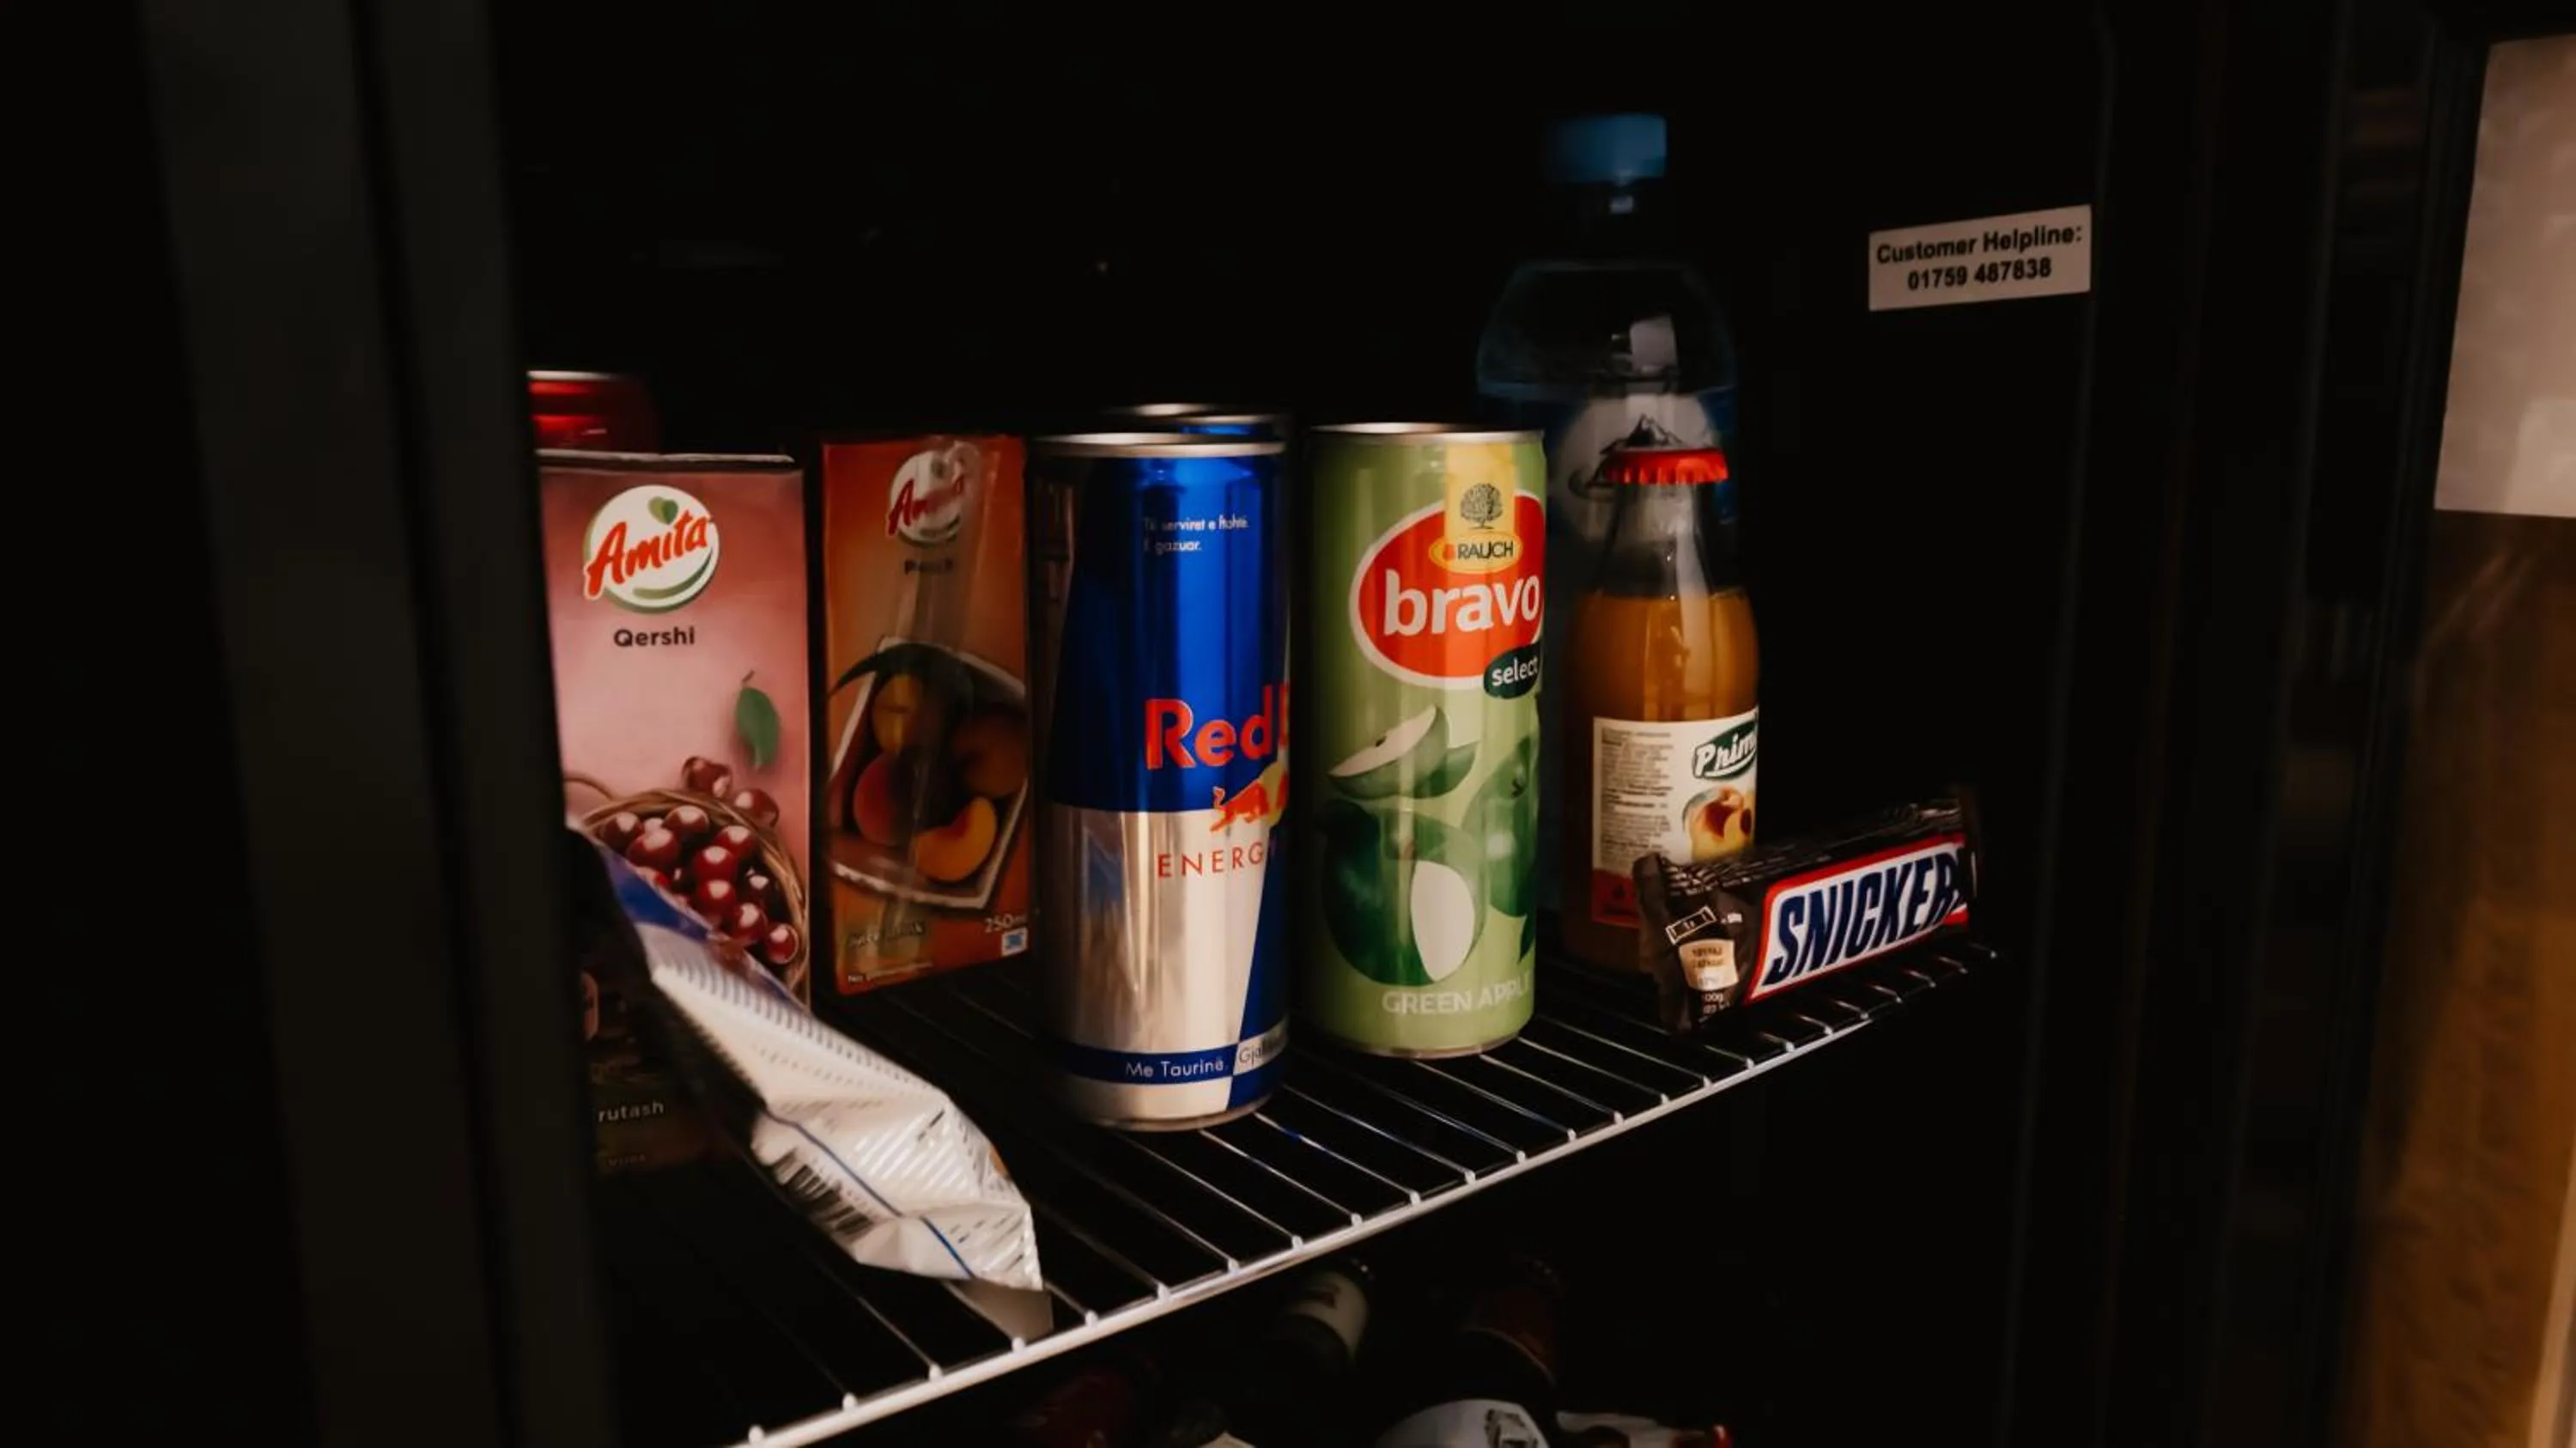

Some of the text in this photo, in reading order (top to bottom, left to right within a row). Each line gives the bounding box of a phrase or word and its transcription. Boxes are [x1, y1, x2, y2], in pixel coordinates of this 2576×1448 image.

[1877, 225, 2082, 263] Customer Helpline:
[1908, 257, 2051, 290] 01759 487838
[586, 510, 708, 596] Amita
[1457, 541, 1514, 560] RAUCH
[1383, 568, 1540, 637] bravo
[613, 626, 695, 647] Qershi
[1491, 656, 1539, 687] select
[1144, 684, 1273, 770] Red
[1158, 840, 1278, 878] ENERG
[1765, 850, 1962, 985] SNICKER
[1382, 989, 1472, 1015] GREEN
[1126, 1061, 1154, 1078] Me
[598, 1099, 665, 1123] rutash
